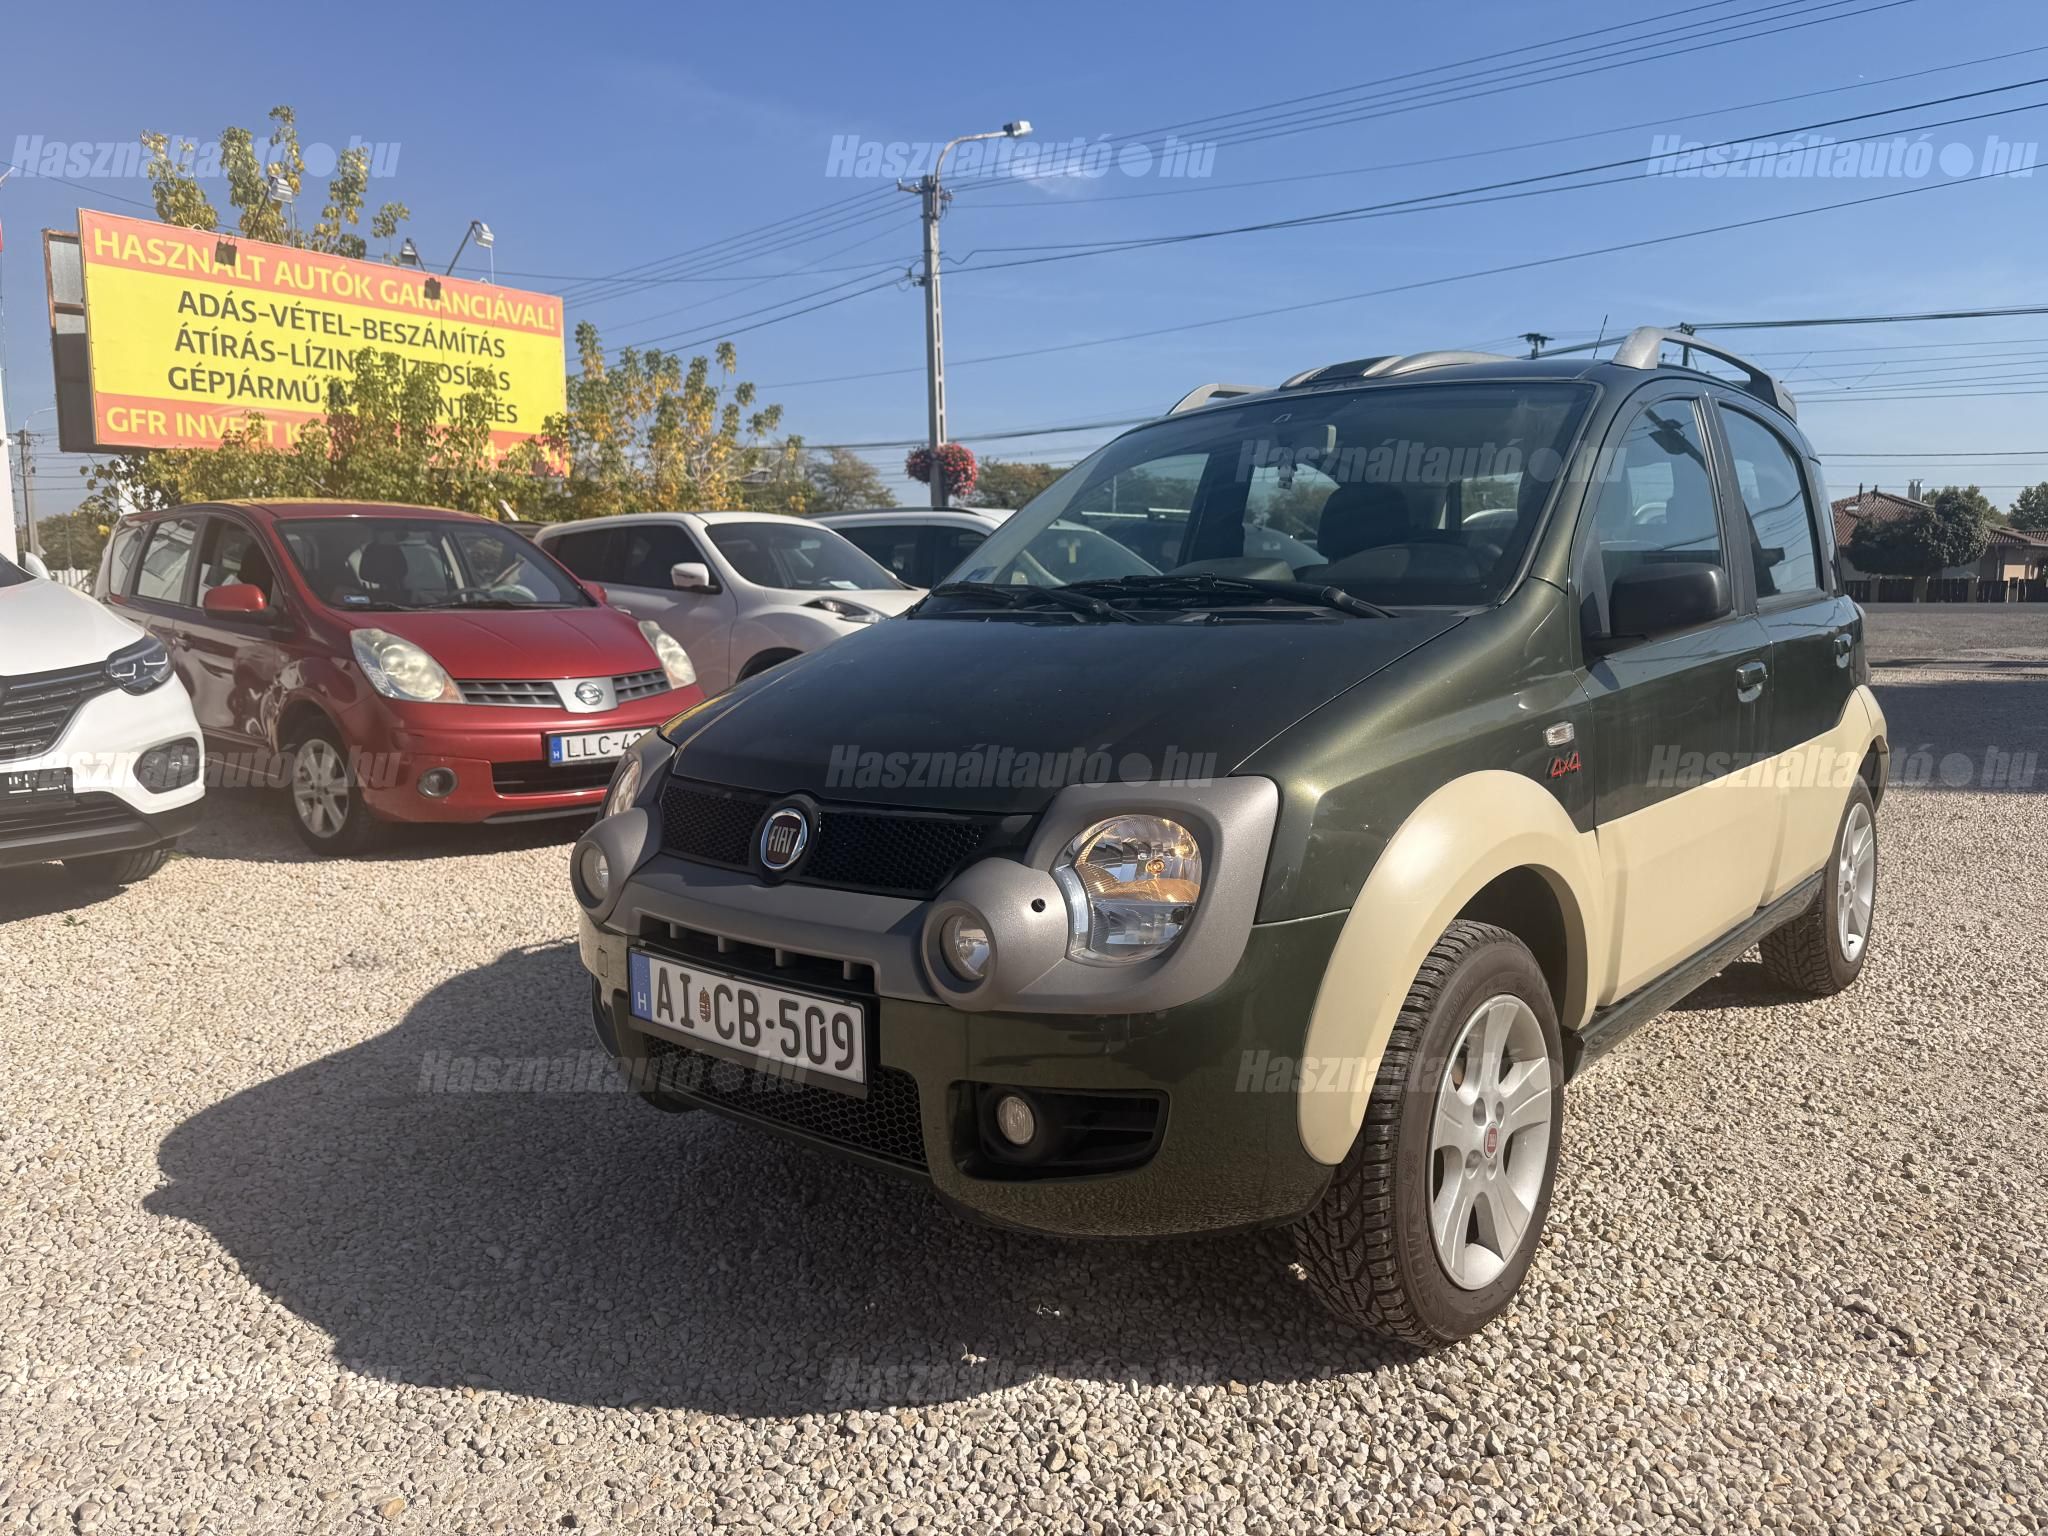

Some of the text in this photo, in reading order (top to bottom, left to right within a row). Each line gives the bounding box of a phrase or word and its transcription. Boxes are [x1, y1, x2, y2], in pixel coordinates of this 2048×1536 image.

[274, 261, 374, 301] AUTÓK
[167, 361, 321, 404] GÉPJÁRMŰ
[106, 406, 168, 436] GFR
[566, 732, 641, 758] LLC-4
[767, 825, 797, 854] FIAT
[636, 966, 855, 1071] H AI CB-509
